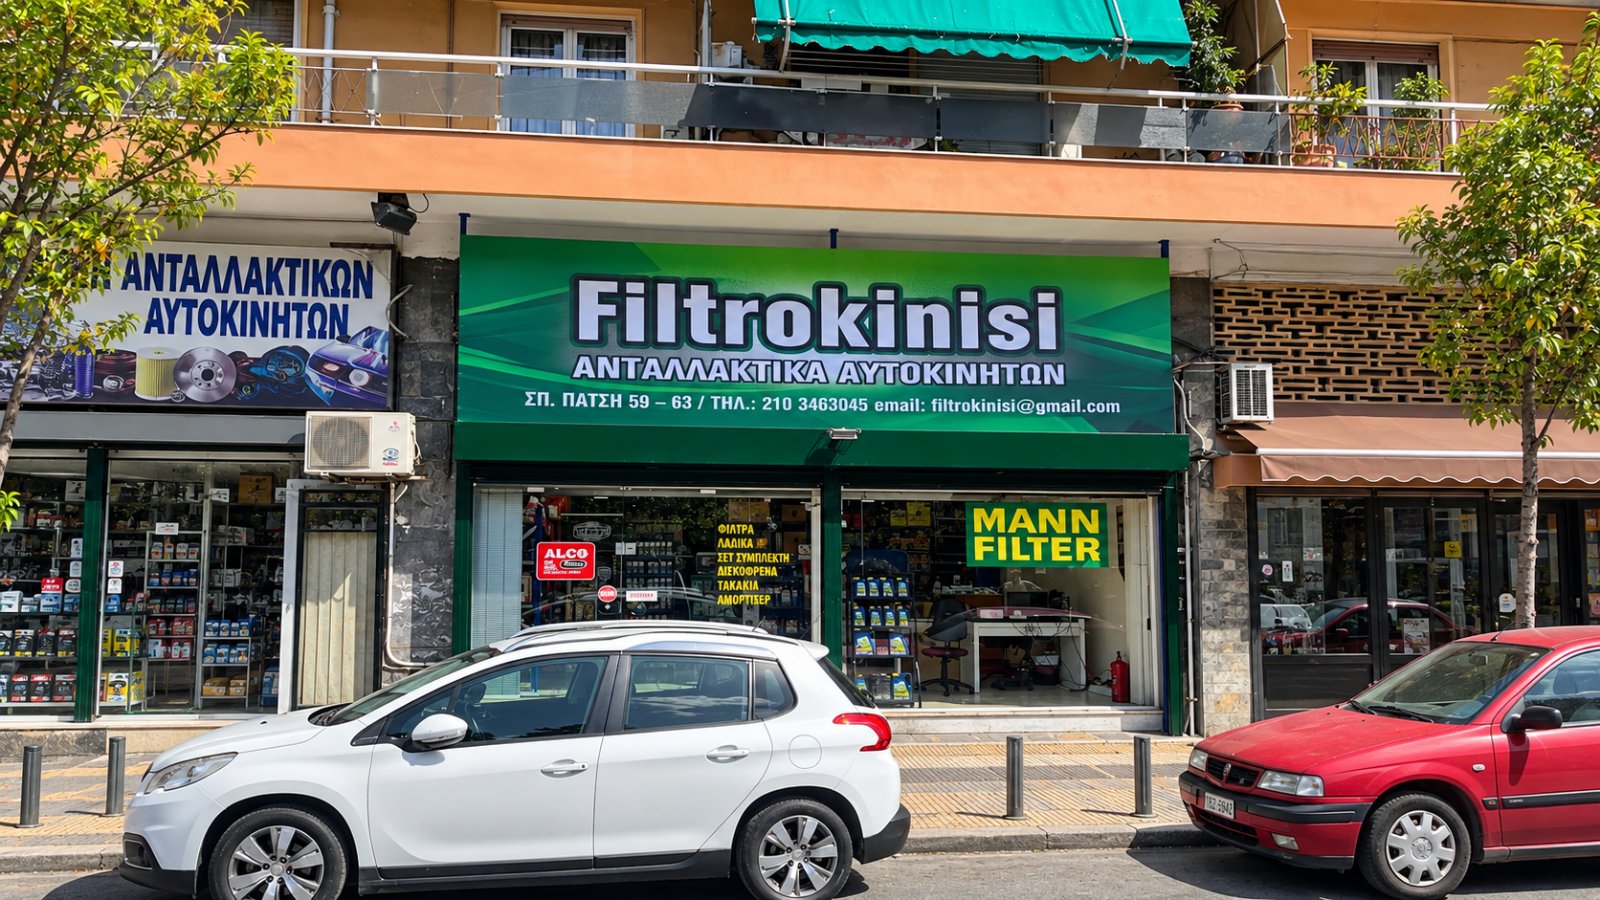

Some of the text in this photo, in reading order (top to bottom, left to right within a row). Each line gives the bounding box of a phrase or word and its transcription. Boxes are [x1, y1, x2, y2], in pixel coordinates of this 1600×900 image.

[121, 252, 374, 299] ΑΝΤΑΛΛΑΚΤΙΚΩΝ
[143, 297, 350, 340] ΑΥΤΟΚΙΝΗΤΩΝ
[575, 277, 1060, 353] Filtrokinisi
[572, 356, 1066, 386] ΑΝΤΑΛΛΑΚΤΙΚΑ ΑΥΤΟΚΙΝΗΤΩΝ
[524, 391, 555, 408] ΣΠ.
[562, 392, 622, 409] ΠΑΤΣΗ
[628, 393, 650, 409] 59
[671, 394, 692, 410] 63
[697, 394, 705, 411] /
[711, 395, 756, 411] ΤΗΛ.:
[762, 396, 792, 411] 210
[797, 396, 868, 412] 3463045
[874, 397, 926, 412] email:
[931, 398, 1121, 416] filtrokinisi@gmail.com
[717, 523, 755, 535] ΦΙΛΤΡΑ
[973, 507, 1100, 534] MANN
[544, 548, 589, 559] ALCO
[717, 537, 754, 549] ΛΑΔΙΚΑ
[973, 536, 1101, 562] FILTER
[717, 552, 790, 563] ΣΕΤ ΣΥΜΠΛΕΚΤΗ
[717, 580, 759, 591] ΤΑΚΑΚΙΑ
[717, 594, 771, 605] ΑΜΟΡΤΙΣΕΡ
